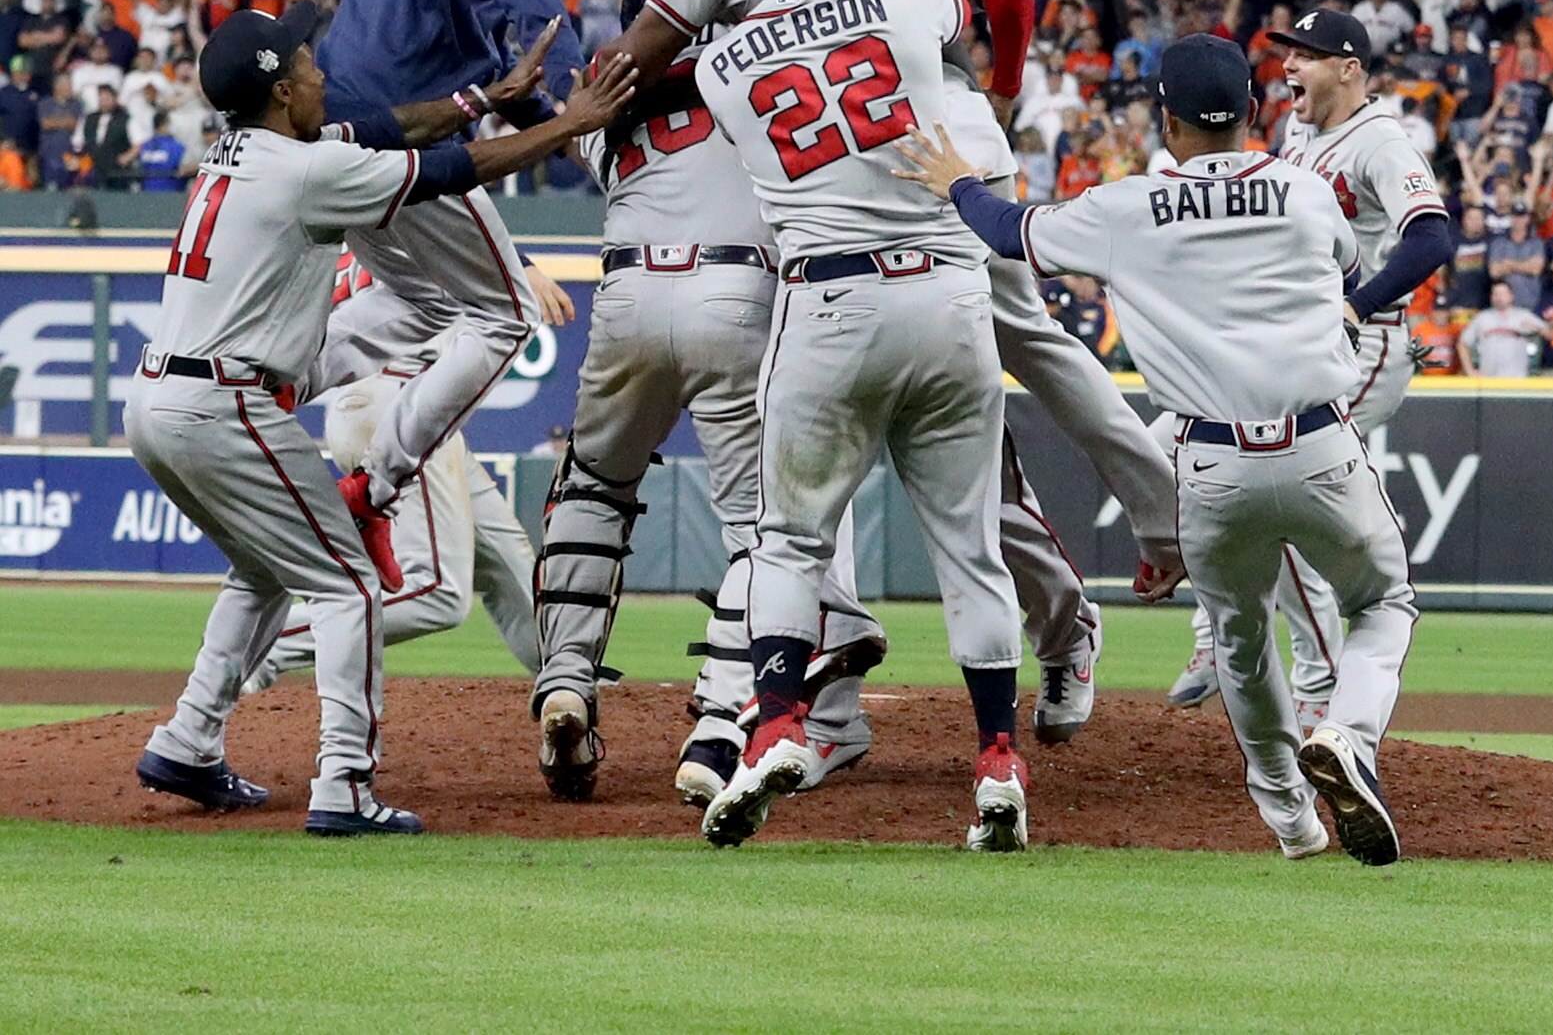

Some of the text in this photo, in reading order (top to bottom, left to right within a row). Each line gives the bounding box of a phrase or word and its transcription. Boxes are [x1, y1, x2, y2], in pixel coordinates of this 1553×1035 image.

[749, 35, 919, 182] 22
[1149, 178, 1290, 227] BAT BOY
[0, 477, 72, 528] nia
